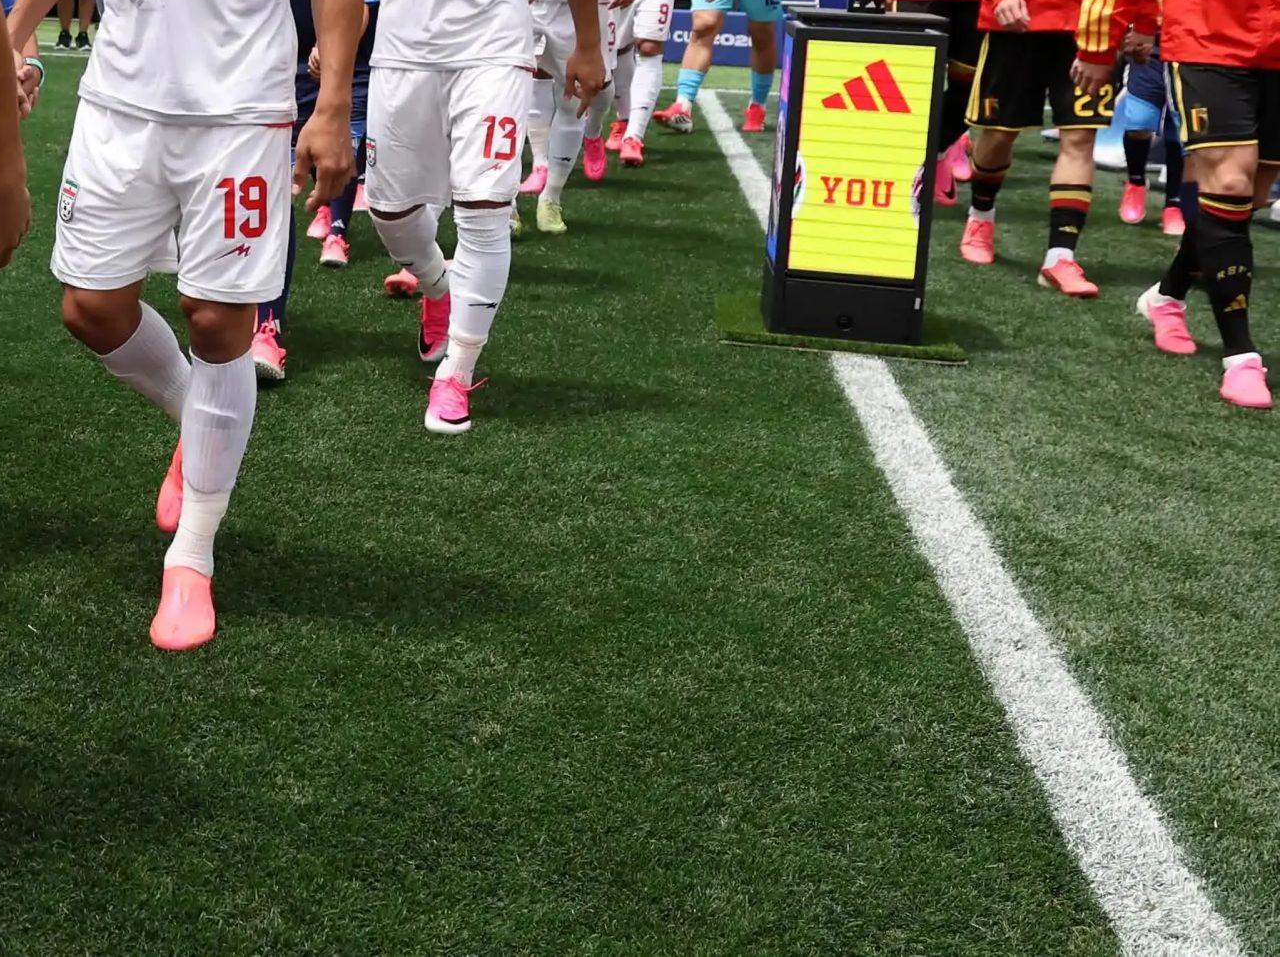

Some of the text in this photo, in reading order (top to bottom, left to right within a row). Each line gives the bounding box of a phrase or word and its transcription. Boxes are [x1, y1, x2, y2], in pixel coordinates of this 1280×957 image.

[658, 3, 669, 25] 9
[672, 30, 692, 43] CU
[1073, 83, 1114, 117] 22
[482, 115, 517, 161] 13
[215, 176, 268, 239] 19
[820, 175, 895, 208] YOU
